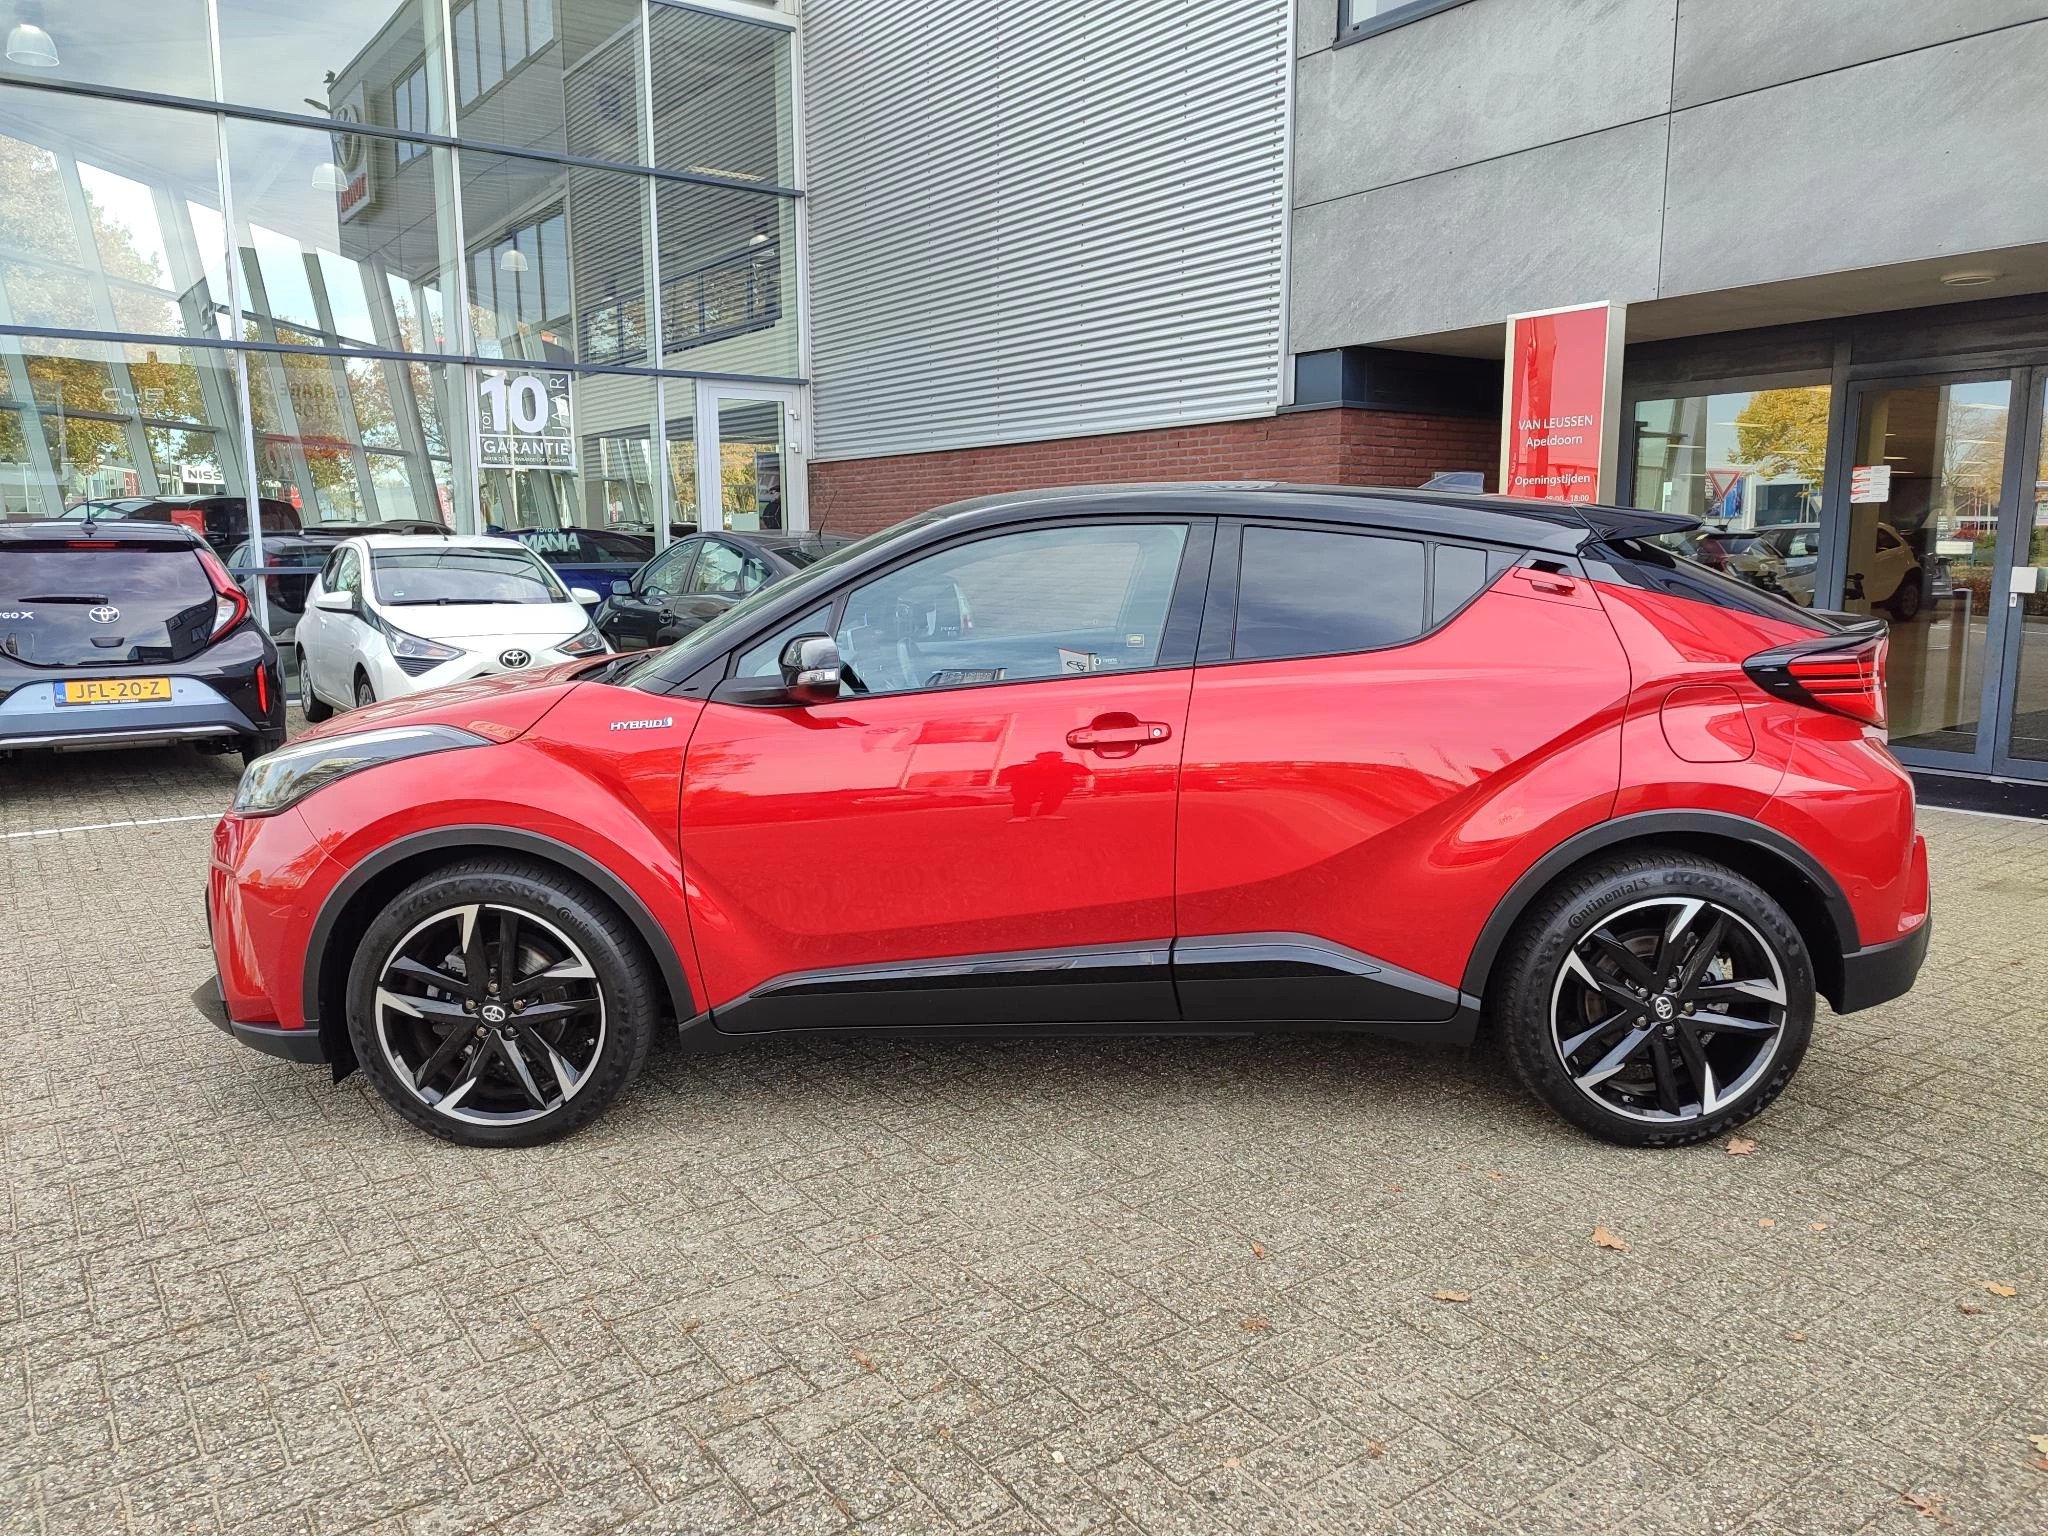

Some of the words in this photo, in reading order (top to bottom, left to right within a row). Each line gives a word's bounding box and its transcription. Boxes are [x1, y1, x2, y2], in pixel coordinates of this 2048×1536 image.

[480, 373, 548, 433] 10
[550, 377, 568, 437] JAAR
[482, 410, 492, 432] TOT
[1518, 419, 1541, 430] VAN
[1543, 415, 1594, 429] LEUSSEN
[483, 441, 569, 456] GARANTIE
[1526, 435, 1584, 450] Apeldoorn
[1514, 473, 1591, 488] Openingstijden
[1570, 494, 1590, 502] 18:00
[518, 532, 581, 553] MANIA
[76, 681, 161, 699] JFL-20-Z
[610, 719, 664, 731] HYBRID
[1568, 879, 1639, 929] Continental
